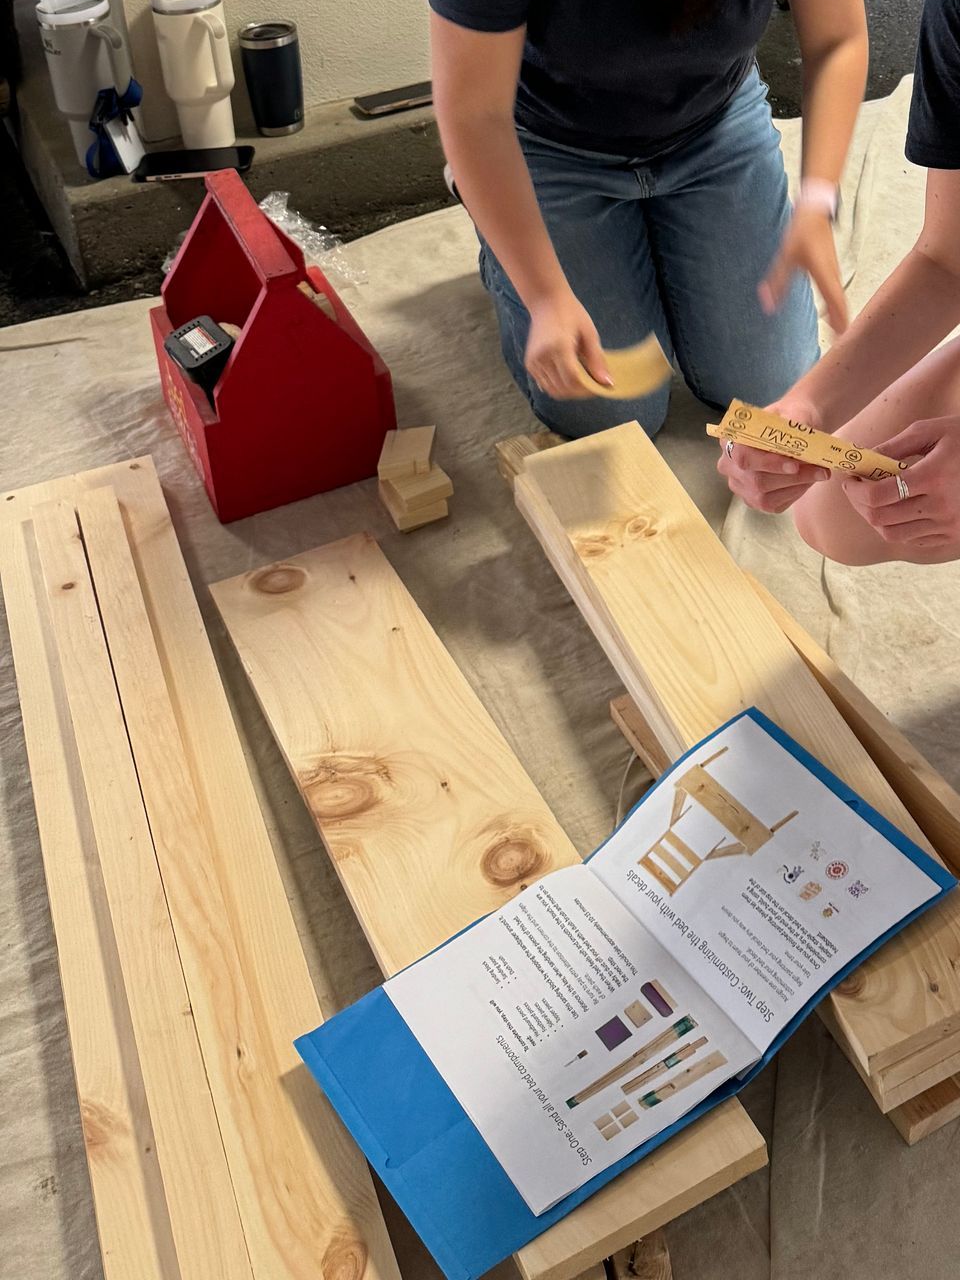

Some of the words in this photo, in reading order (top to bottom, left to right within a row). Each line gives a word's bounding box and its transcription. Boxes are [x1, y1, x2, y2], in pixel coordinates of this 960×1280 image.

[623, 868, 648, 894] decals
[644, 886, 664, 907] your
[656, 902, 677, 923] with
[670, 917, 689, 936] bed
[683, 930, 701, 948] the
[695, 939, 743, 988] Customizing
[734, 982, 758, 1006] Two:
[752, 998, 777, 1023] Step
[493, 1032, 529, 1076] components
[521, 1072, 537, 1089] bed
[532, 1084, 550, 1104] your
[542, 1101, 554, 1114] all
[548, 1110, 567, 1132] Sand
[561, 1128, 580, 1149] One:
[573, 1144, 594, 1167] Step
